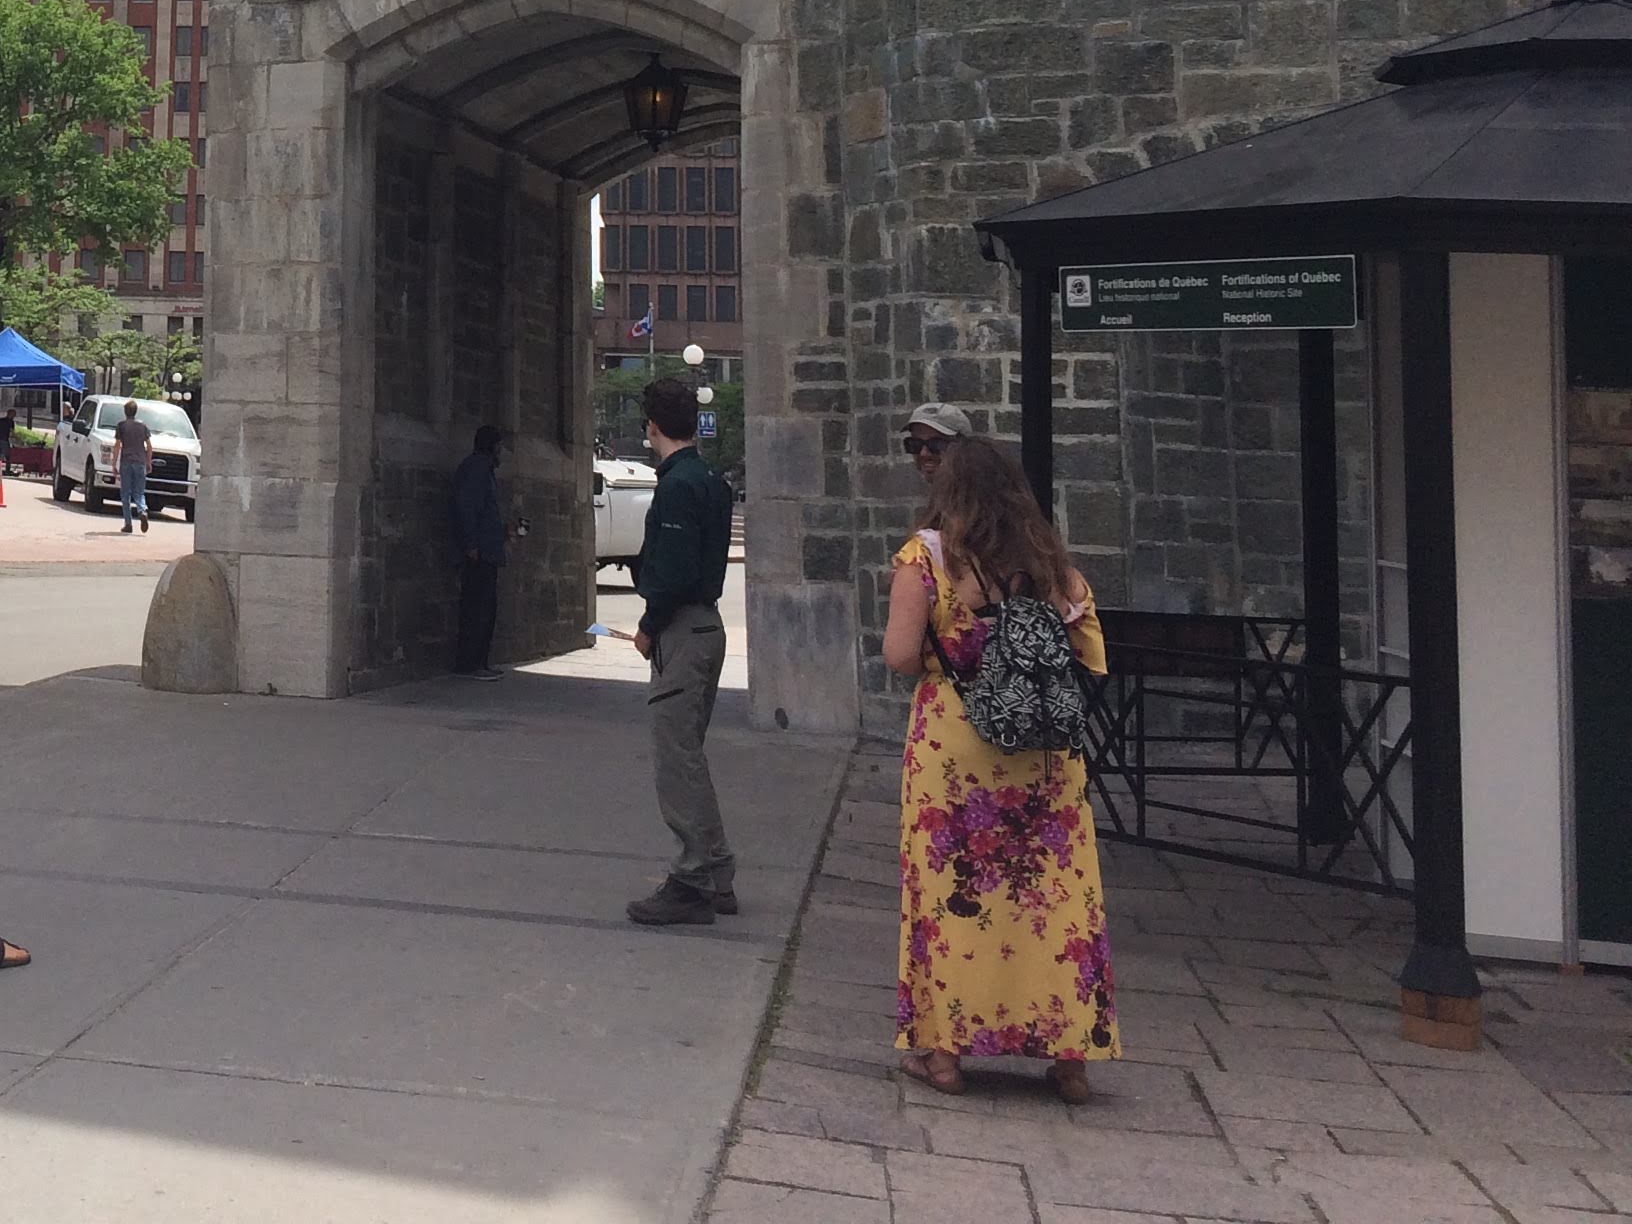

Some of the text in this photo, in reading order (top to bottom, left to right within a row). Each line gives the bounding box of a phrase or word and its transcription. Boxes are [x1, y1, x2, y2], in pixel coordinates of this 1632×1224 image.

[1098, 275, 1209, 289] Fortifications de Québec
[1221, 271, 1342, 286] Fortifications of Québec
[1287, 287, 1303, 298] Site
[1100, 314, 1133, 325] Accueil
[1223, 311, 1272, 325] Reception
